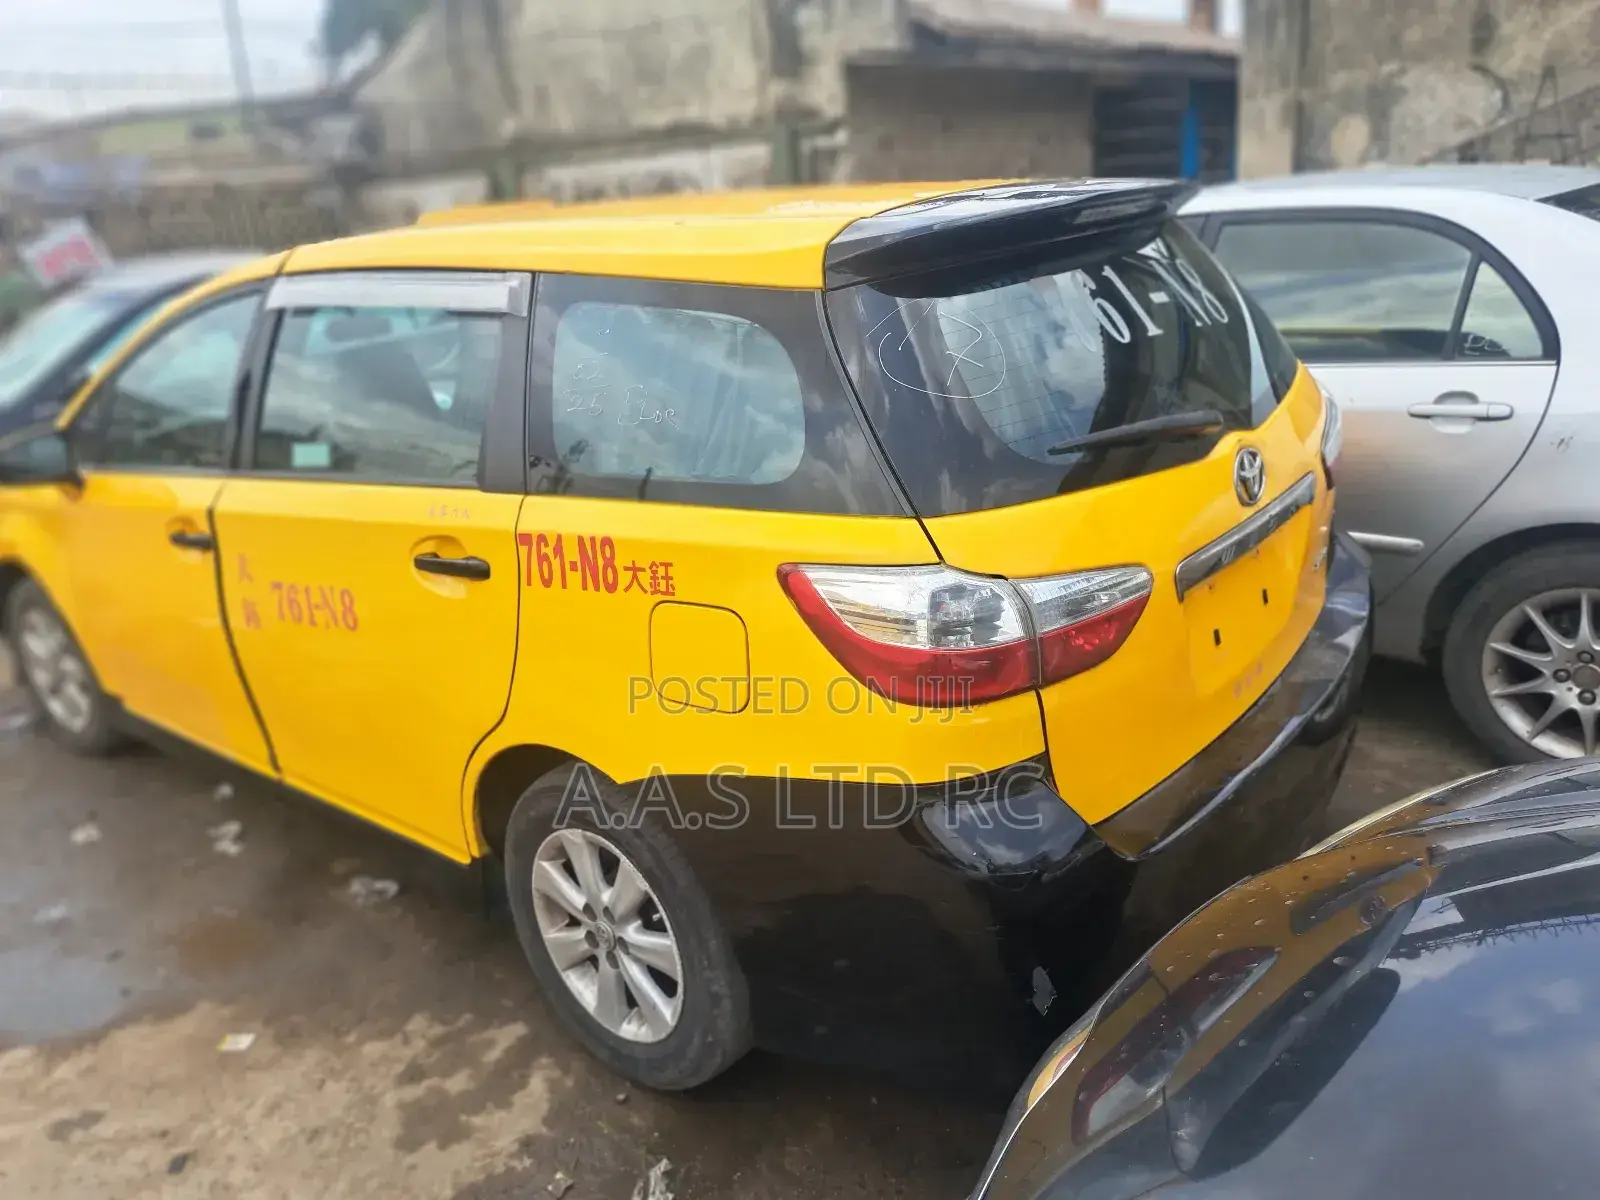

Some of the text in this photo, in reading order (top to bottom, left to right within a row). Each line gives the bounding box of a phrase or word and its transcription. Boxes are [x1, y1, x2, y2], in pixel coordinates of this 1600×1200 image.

[518, 532, 676, 597] 761-N8 大鈺
[270, 581, 359, 632] 761-N8
